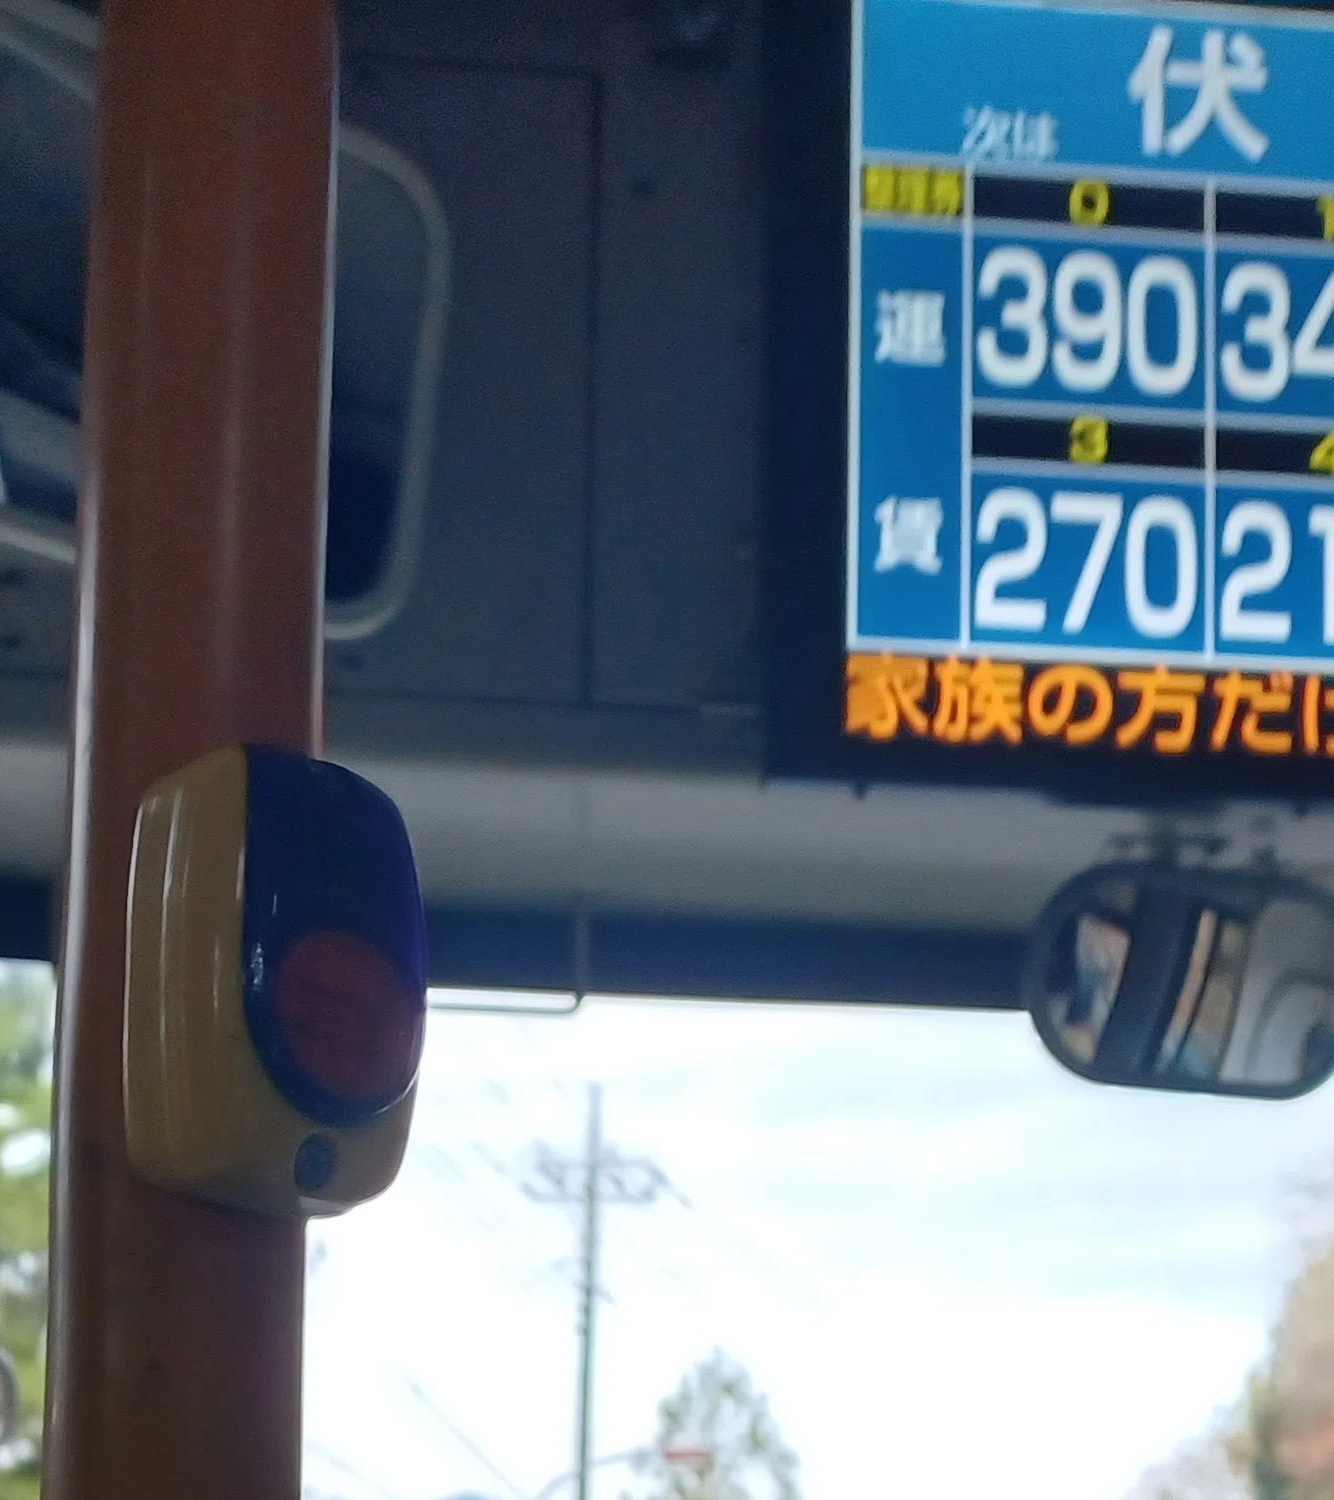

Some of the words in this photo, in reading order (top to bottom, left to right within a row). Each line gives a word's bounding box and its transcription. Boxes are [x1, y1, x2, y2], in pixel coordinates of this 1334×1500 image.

[961, 105, 1058, 160] 次は
[1069, 179, 1110, 227] 0
[976, 245, 1199, 397] 390
[1069, 413, 1109, 466] 3
[974, 487, 1198, 638] 270
